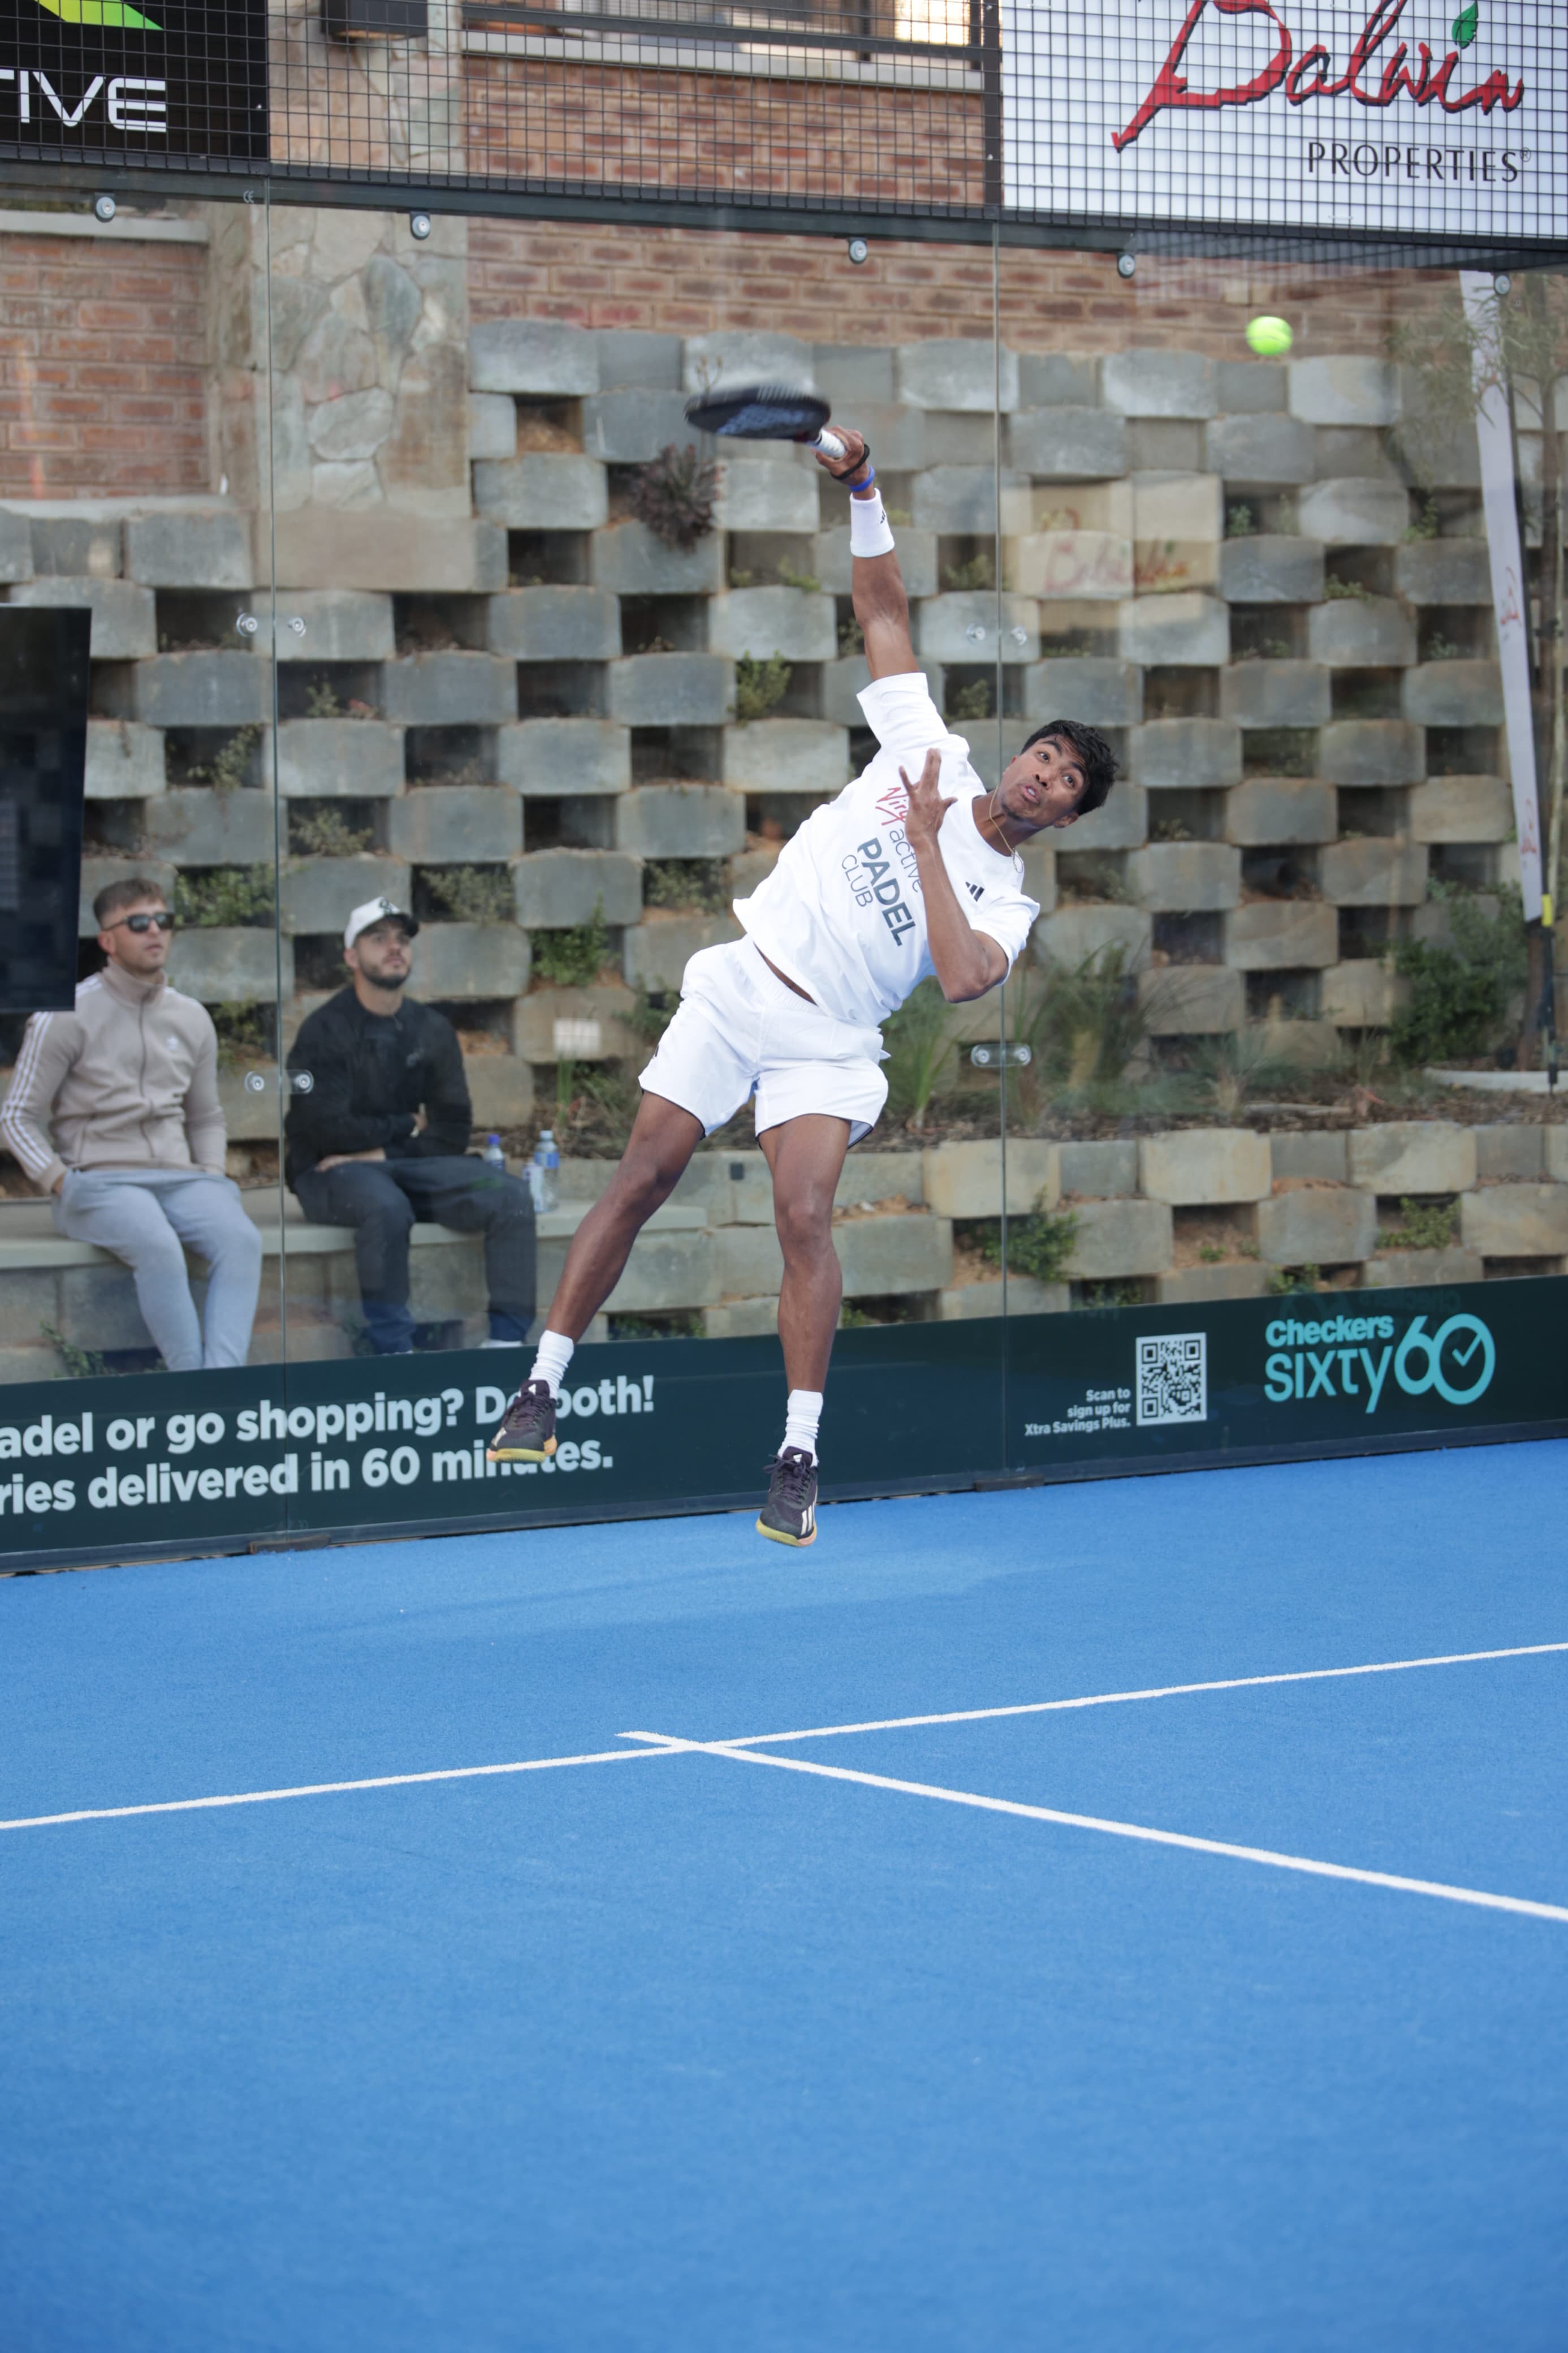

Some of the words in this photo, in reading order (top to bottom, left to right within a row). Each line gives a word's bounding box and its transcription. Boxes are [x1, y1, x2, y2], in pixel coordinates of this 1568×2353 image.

[875, 787, 909, 826] Virg
[841, 854, 874, 907] CLUB
[889, 829, 922, 893] active
[857, 837, 916, 946] PADEL
[1265, 1315, 1394, 1347] Checkers
[1068, 1405, 1094, 1419] sign
[1095, 1404, 1111, 1417] up
[1112, 1401, 1131, 1414] for
[1086, 1389, 1116, 1402] Scan
[1117, 1387, 1131, 1399] to
[106, 1417, 155, 1451] or
[166, 1412, 225, 1454] go
[236, 1388, 464, 1444] shopping?
[1025, 1424, 1051, 1436] Xtra
[1052, 1419, 1100, 1433] Savings
[1102, 1416, 1131, 1429] Plus.
[88, 1453, 299, 1509] delivered
[311, 1451, 350, 1491] in
[362, 1446, 420, 1487] 60
